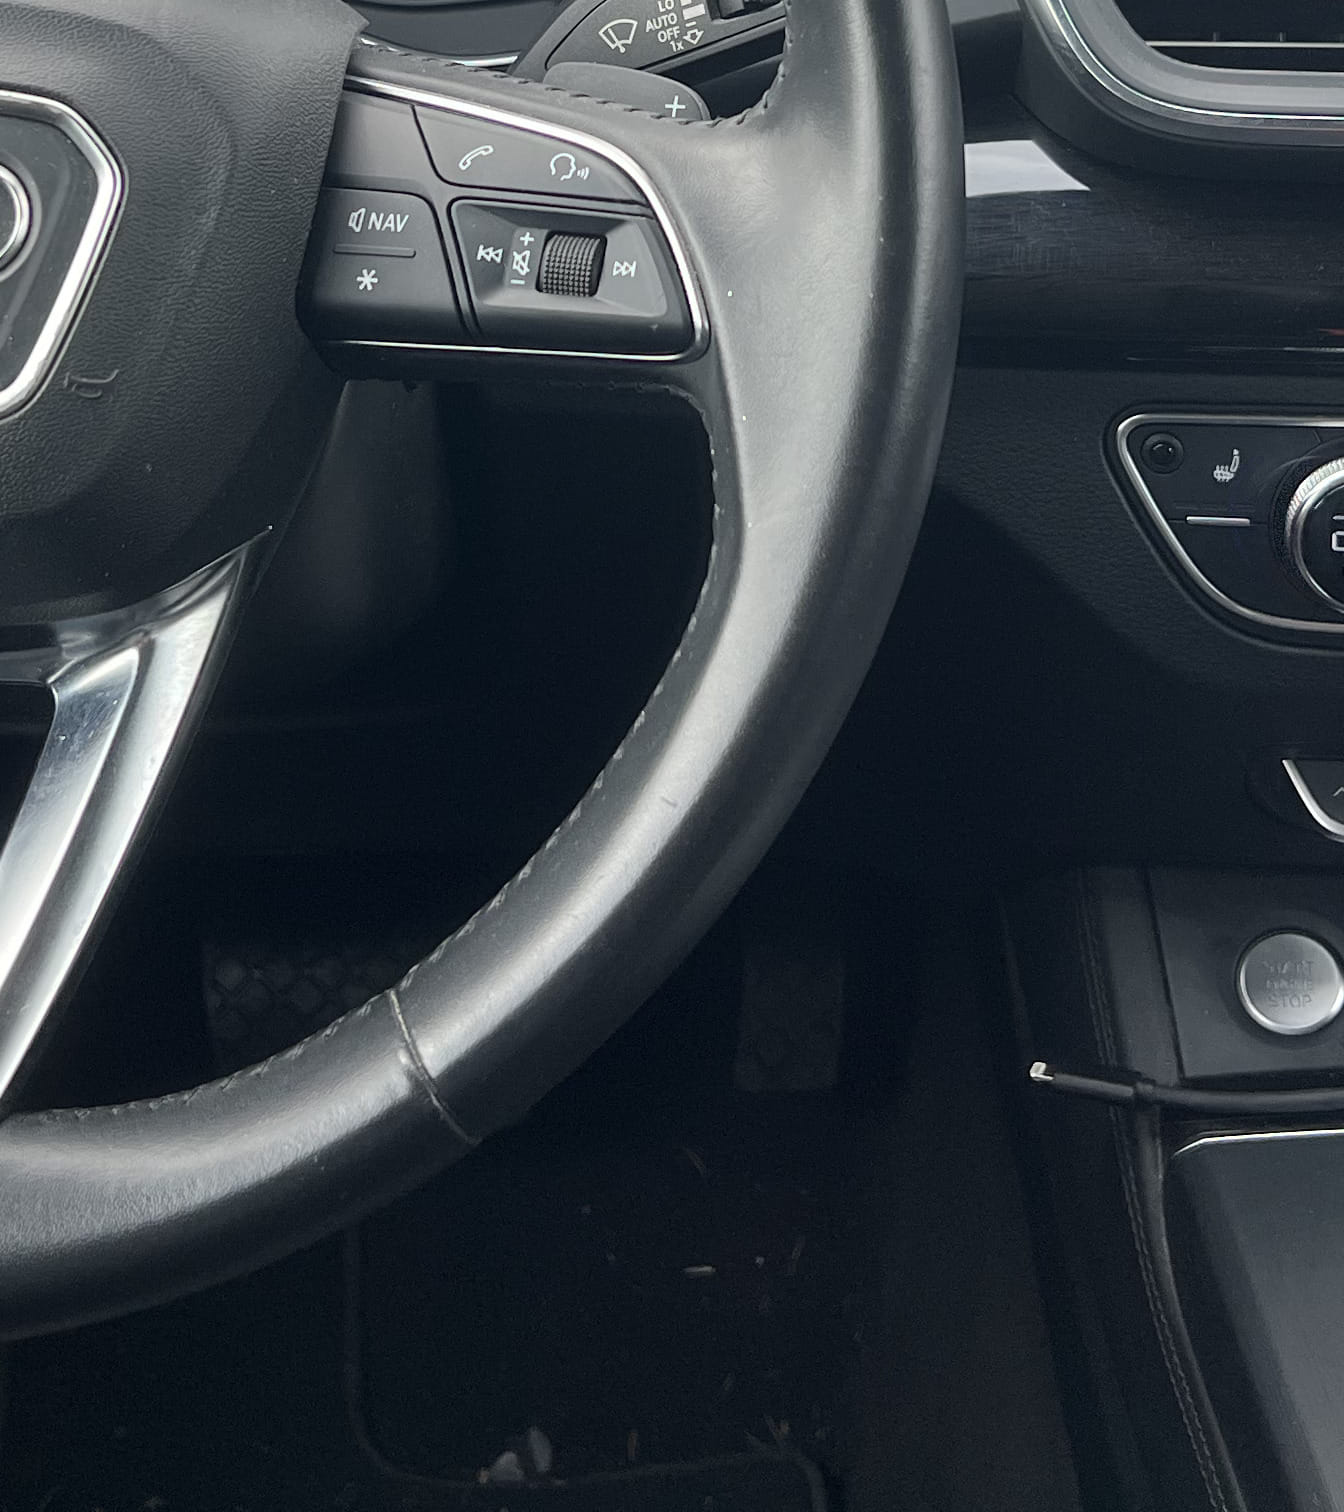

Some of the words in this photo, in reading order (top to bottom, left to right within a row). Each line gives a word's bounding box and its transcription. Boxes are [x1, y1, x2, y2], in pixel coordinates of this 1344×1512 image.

[645, 12, 678, 33] AUTO
[657, 26, 681, 42] OFF
[669, 40, 684, 52] 1x
[367, 212, 409, 233] NAV
[1268, 992, 1313, 1009] STOP
